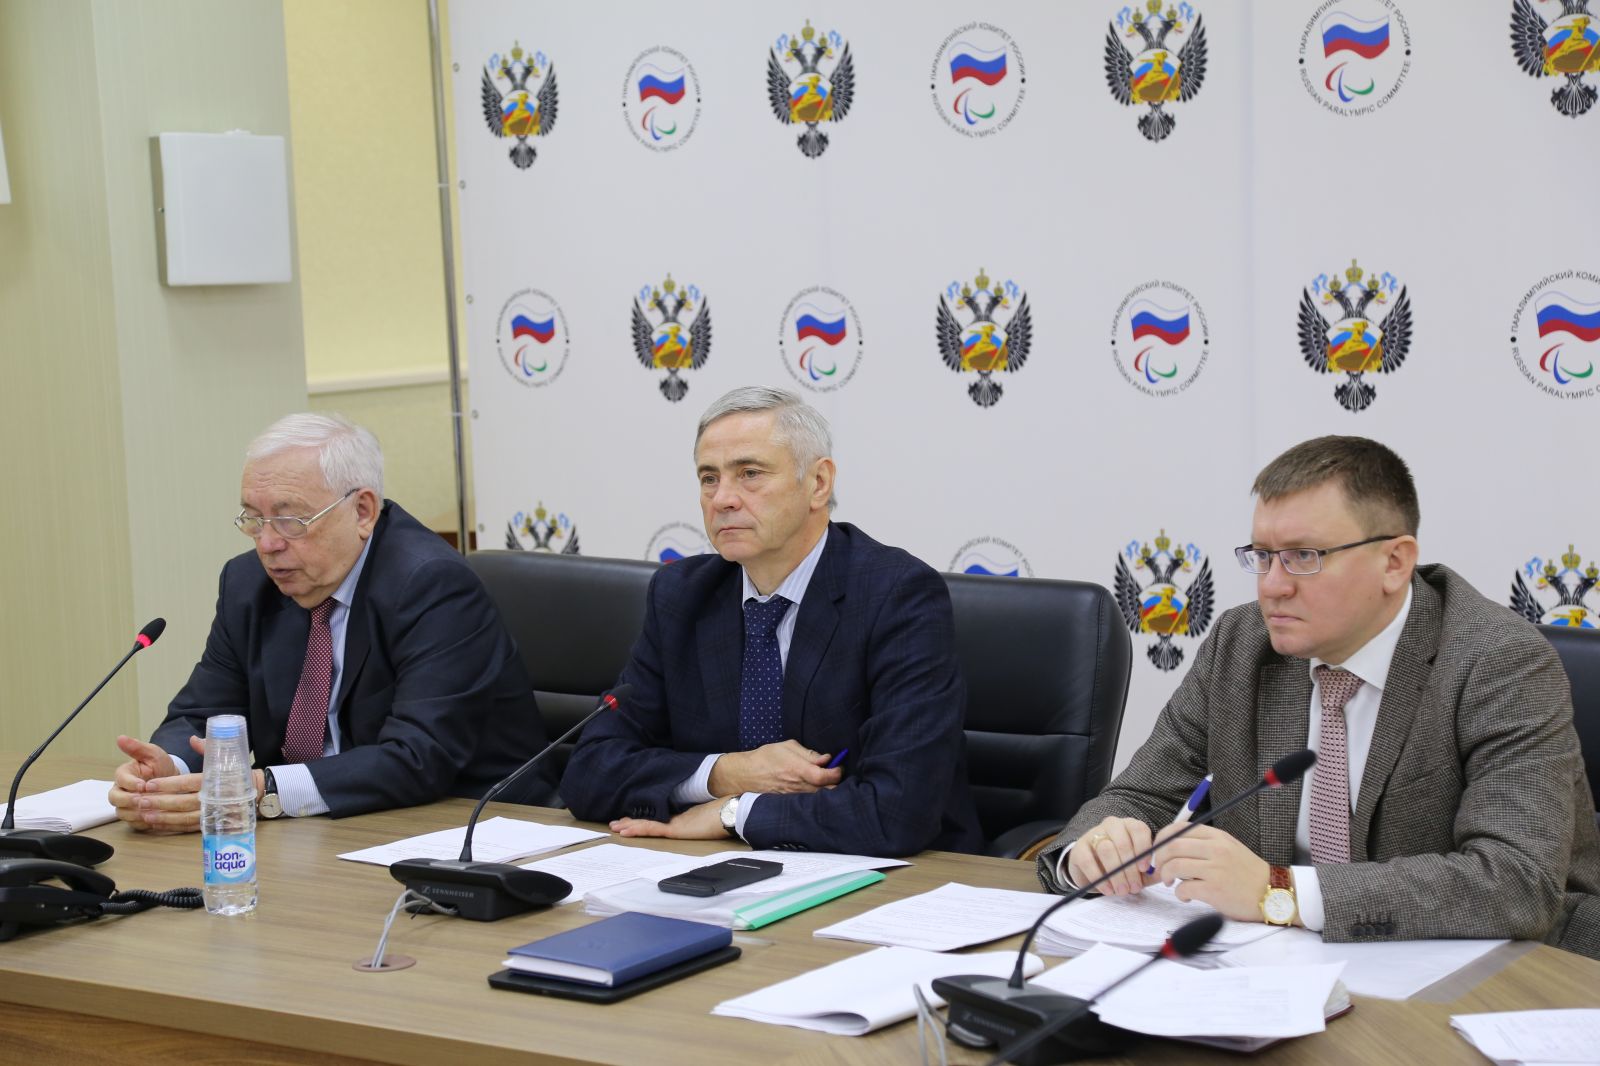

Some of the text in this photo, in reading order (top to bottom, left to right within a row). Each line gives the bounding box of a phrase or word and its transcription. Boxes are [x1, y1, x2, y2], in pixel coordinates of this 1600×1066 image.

[1323, 101, 1376, 117] PARALYMPIC
[1377, 60, 1411, 108] COMMITTEE
[1511, 346, 1537, 384] RUSSIAN
[1536, 383, 1594, 399] PARALYMPIC
[214, 860, 246, 872] aqua
